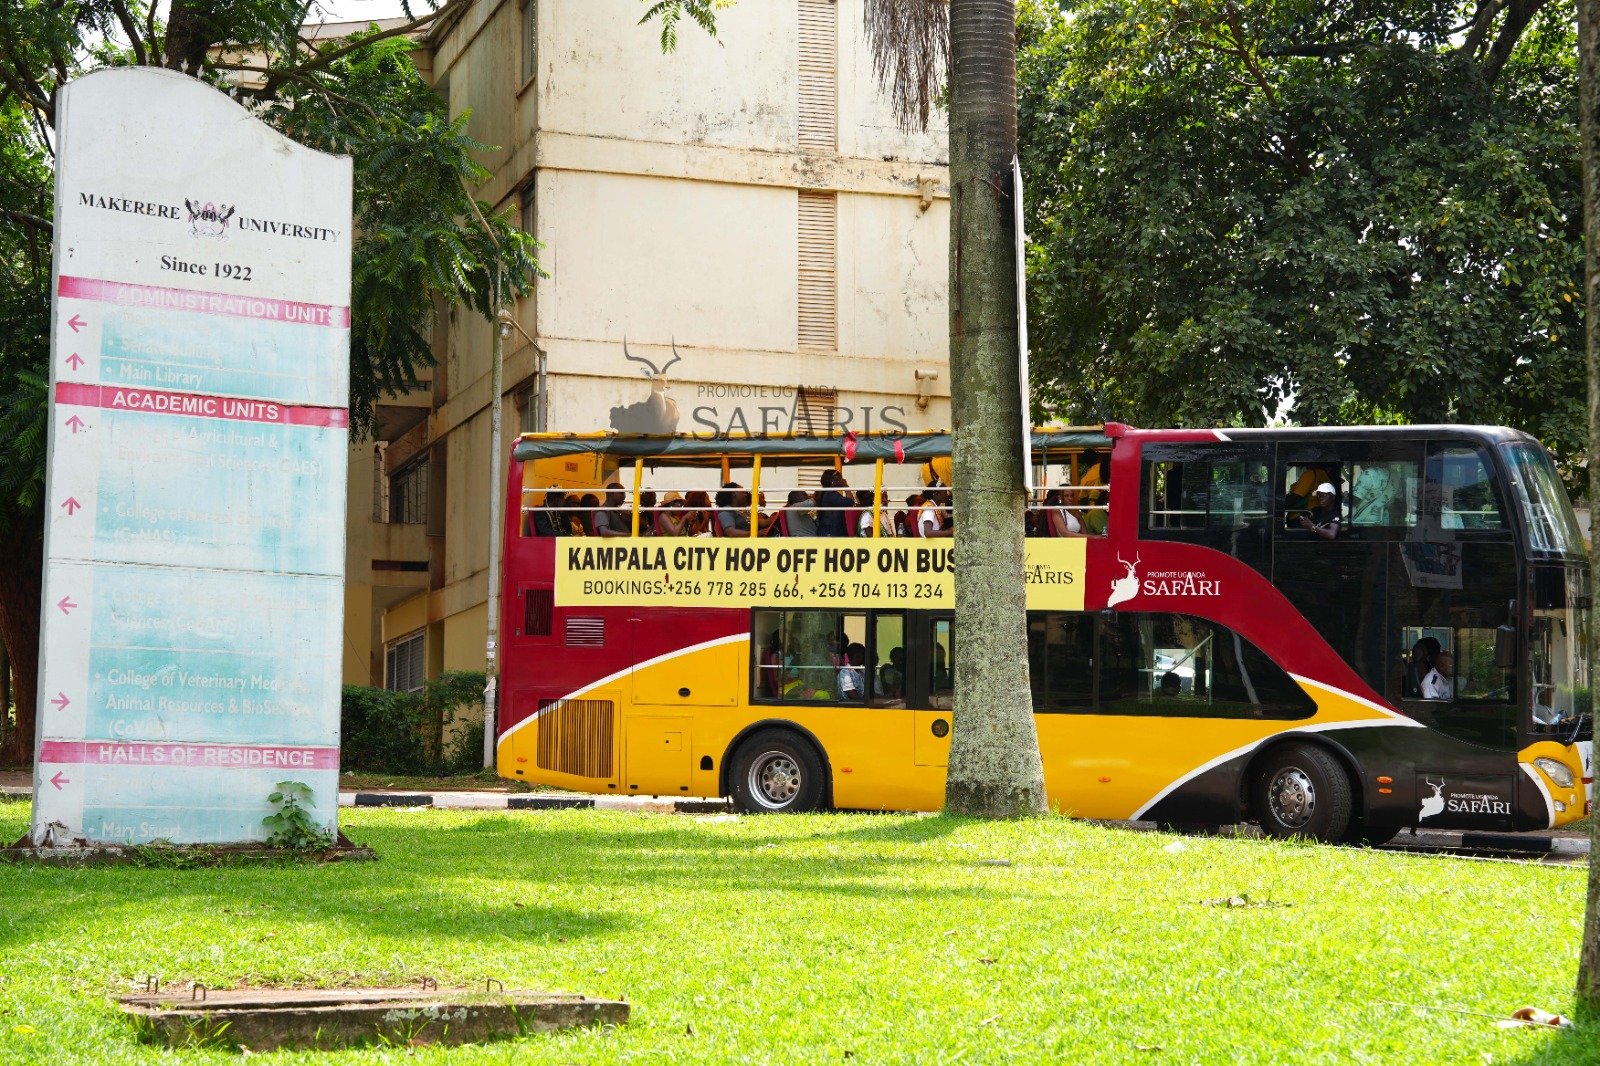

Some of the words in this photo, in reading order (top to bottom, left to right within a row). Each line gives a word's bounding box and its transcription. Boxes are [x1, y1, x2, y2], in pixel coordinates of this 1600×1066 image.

[79, 192, 180, 220] MAKERERE
[239, 216, 341, 243] UNIVERSITY
[160, 254, 207, 276] Since
[214, 262, 252, 282] 1922
[115, 287, 279, 319] ADMINISTRATION
[120, 362, 151, 380] Main
[155, 366, 204, 389] Library
[112, 390, 217, 415] ACADEMIC
[222, 403, 279, 420] UNITS
[269, 433, 278, 448] &
[568, 546, 667, 571] KAMPALA
[673, 546, 720, 571] CITY
[725, 547, 770, 572] HOP
[776, 548, 818, 573] OFF
[824, 548, 870, 573] HOP
[877, 548, 909, 573] ON
[916, 548, 955, 573] BUS
[1025, 564, 1074, 584] FARIS
[1143, 572, 1221, 596] SAFARI
[707, 581, 733, 596] 778
[739, 582, 766, 597] 285
[773, 583, 804, 599] 666,
[809, 582, 846, 598] +256
[853, 583, 881, 598] 704
[887, 583, 908, 598] 113
[914, 583, 943, 599] 234
[107, 668, 158, 690] College
[162, 671, 175, 686] of
[178, 672, 247, 694] Veterinary
[106, 693, 152, 711] Animal
[159, 695, 224, 714] Resources
[228, 697, 239, 713] &
[99, 746, 164, 762] HALLS
[171, 748, 199, 764] OF
[204, 749, 315, 766] RESIDENCE
[1447, 795, 1511, 814] SAFARI
[102, 821, 136, 839] Mary
[140, 822, 182, 838] Stuart
